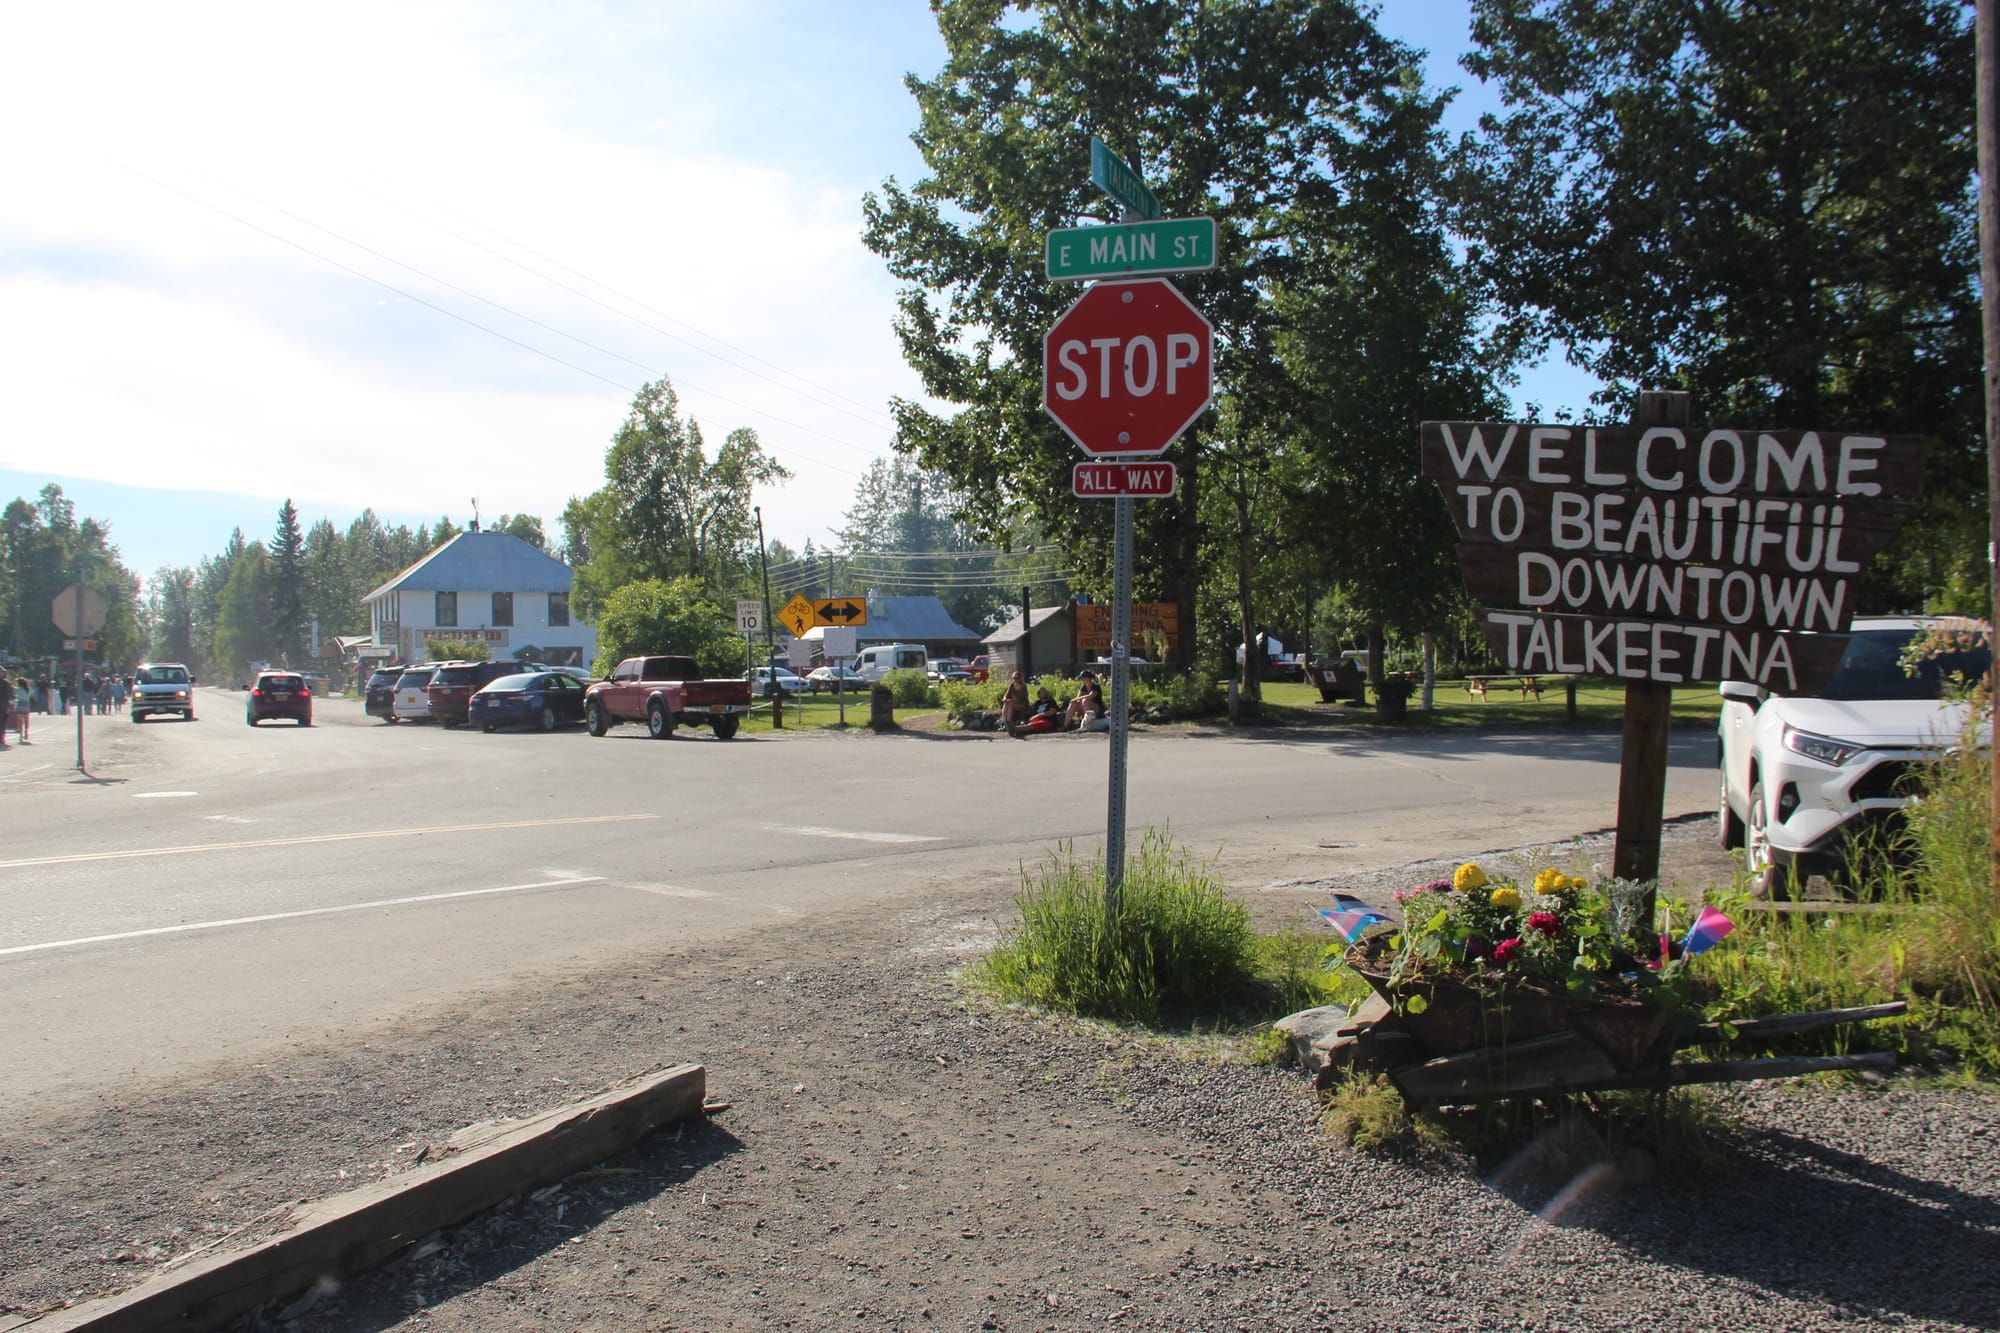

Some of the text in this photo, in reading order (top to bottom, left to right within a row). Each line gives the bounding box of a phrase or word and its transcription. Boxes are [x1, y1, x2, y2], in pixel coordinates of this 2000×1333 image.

[1060, 245, 1072, 267] E
[1090, 233, 1156, 264] MAIN
[1055, 332, 1201, 401] STOP
[1081, 470, 1165, 491] ALL WAY
[1440, 423, 1887, 497] WELCOME
[1456, 485, 1860, 574] TO BEAUTIFUL
[742, 616, 757, 629] 10
[1518, 552, 1846, 632] DOWNTOWN
[1487, 612, 1798, 691] TALKEETNA
